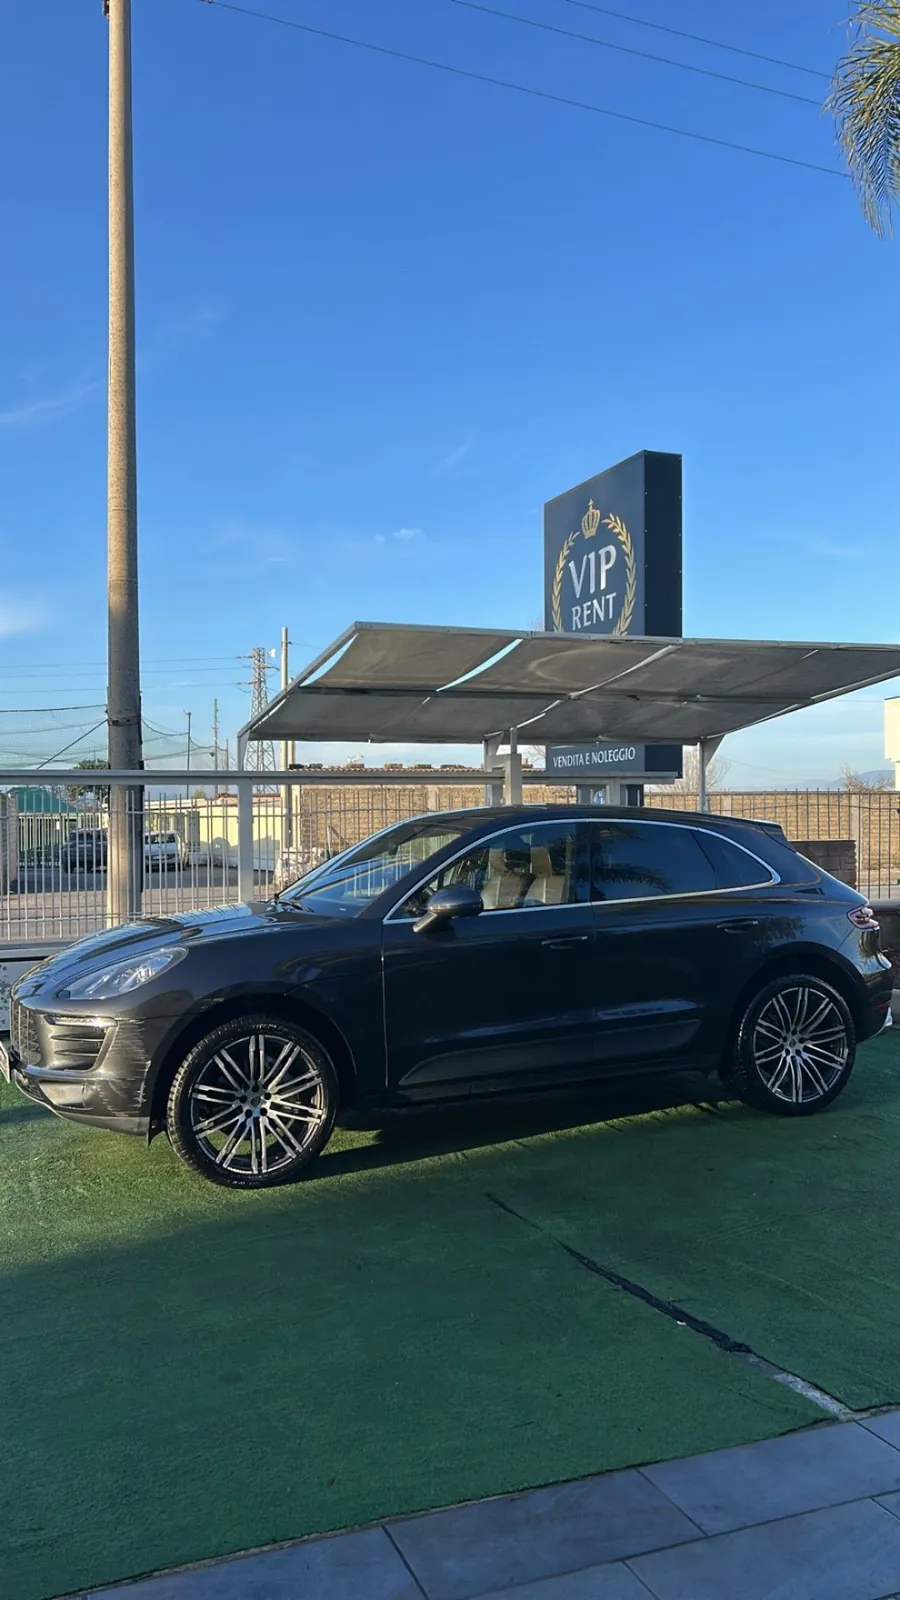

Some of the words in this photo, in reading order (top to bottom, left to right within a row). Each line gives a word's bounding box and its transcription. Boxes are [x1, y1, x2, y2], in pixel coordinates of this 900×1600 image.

[569, 545, 617, 599] VIP
[572, 592, 617, 631] RENT
[552, 754, 584, 768] VENDITA
[585, 752, 590, 765] E
[592, 747, 636, 764] NOLEGGIO
